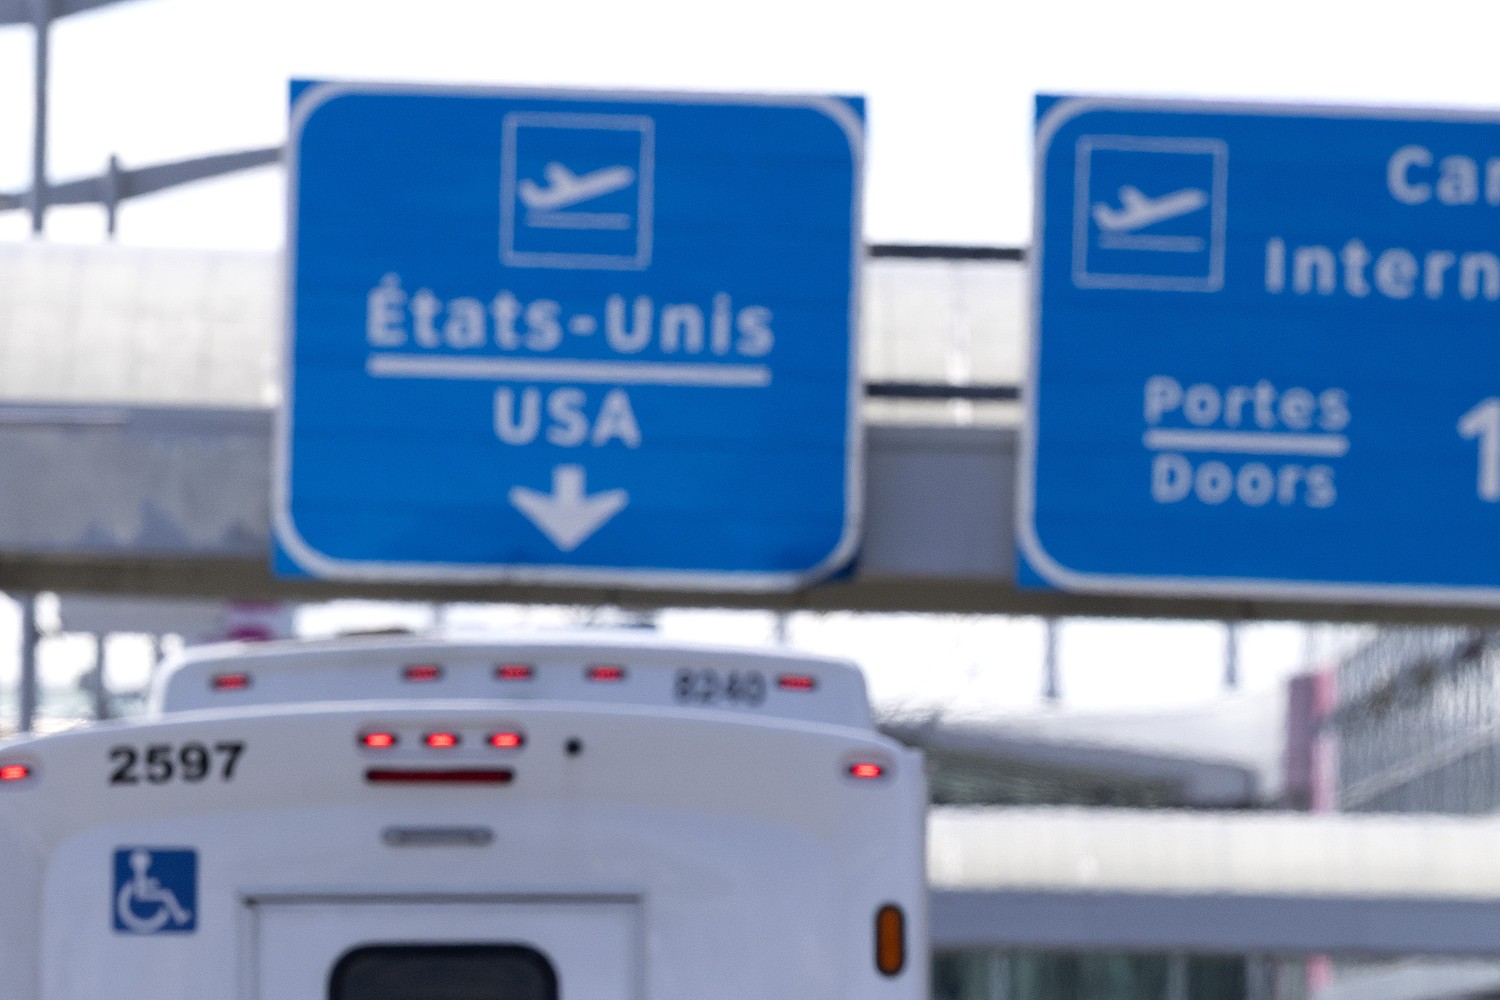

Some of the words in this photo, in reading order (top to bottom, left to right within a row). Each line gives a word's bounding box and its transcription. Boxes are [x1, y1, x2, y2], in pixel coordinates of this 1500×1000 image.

[366, 272, 774, 356] États-Unis
[494, 387, 641, 447] USA
[1144, 376, 1350, 430] Portes
[1151, 454, 1336, 508] Doors
[674, 668, 766, 705] 8240
[109, 741, 245, 785] 2597
